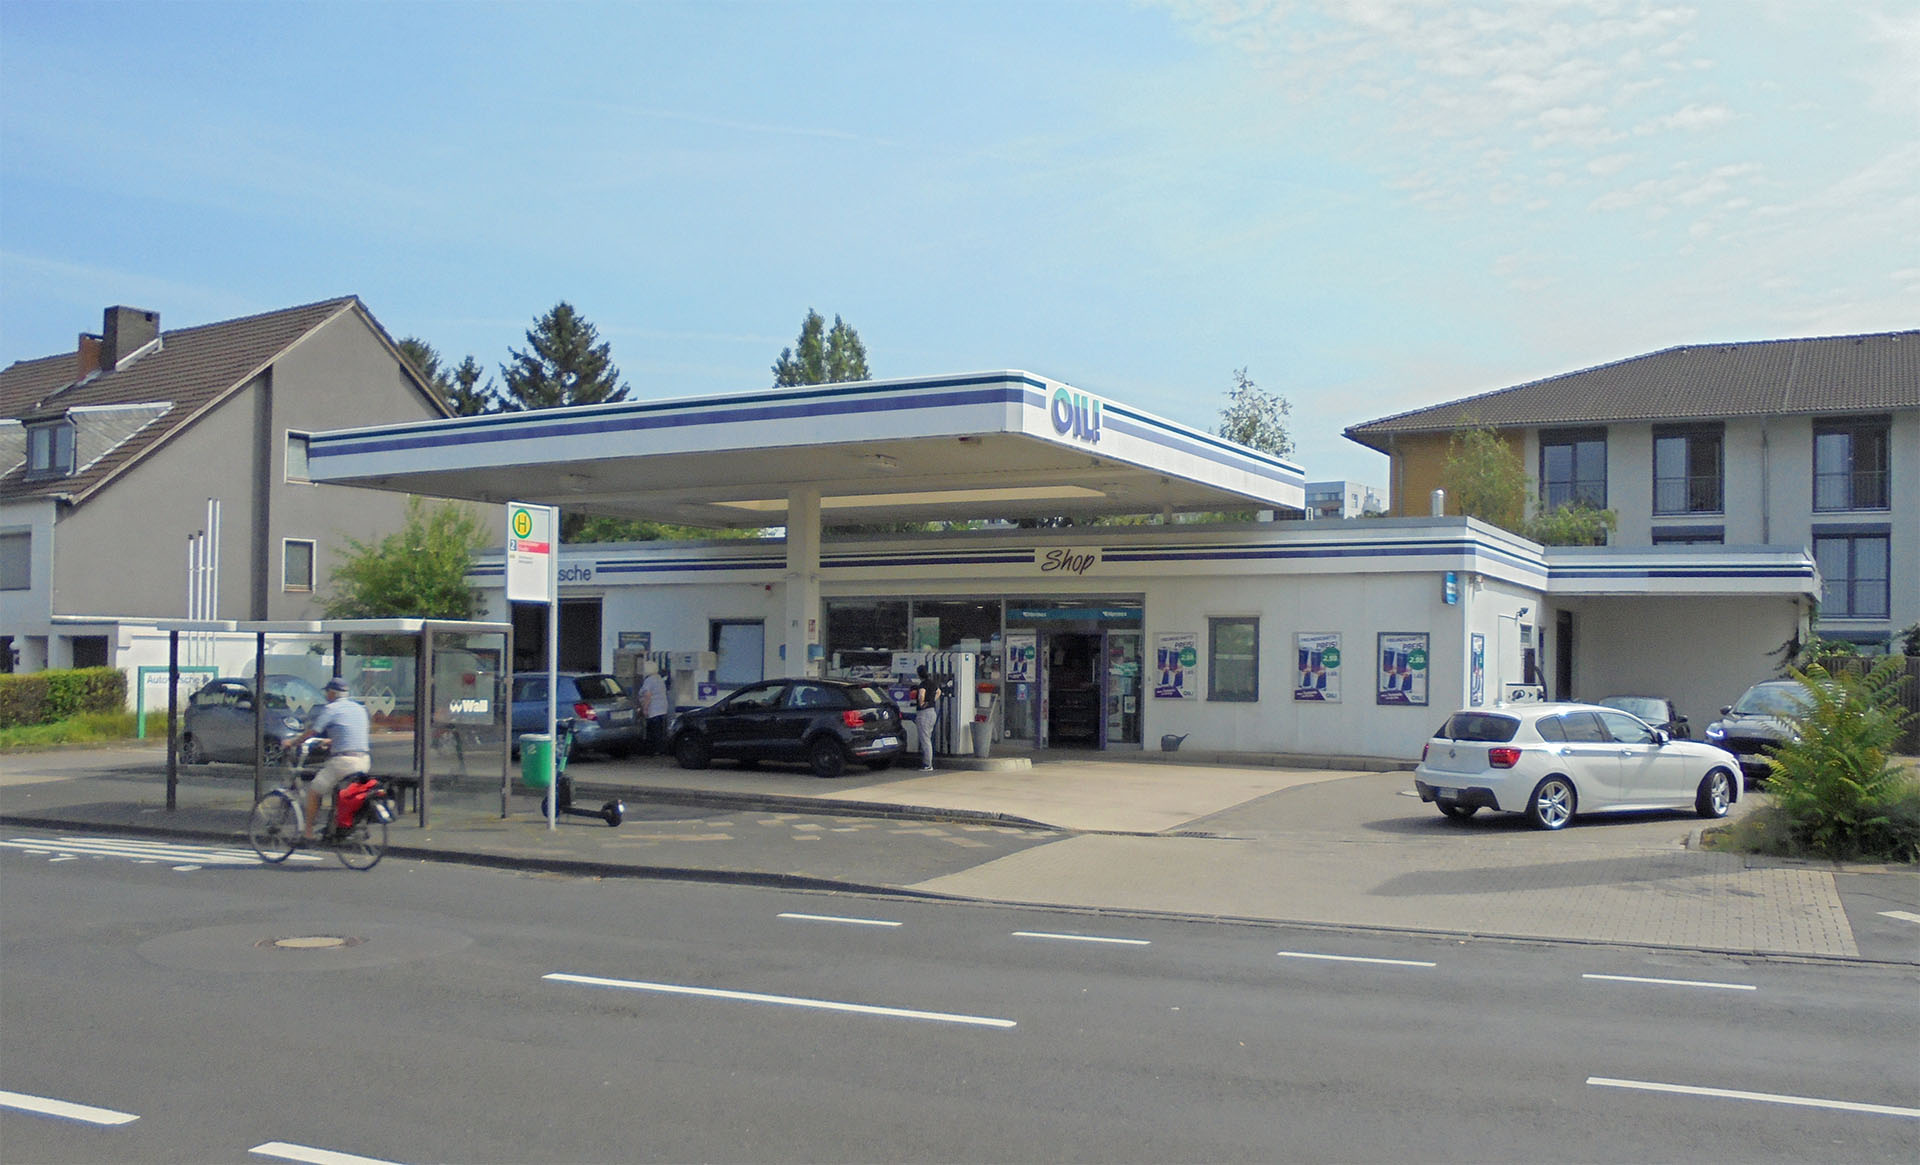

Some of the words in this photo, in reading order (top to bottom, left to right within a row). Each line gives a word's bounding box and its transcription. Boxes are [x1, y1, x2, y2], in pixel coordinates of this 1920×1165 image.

[1051, 387, 1100, 445] OIL!
[517, 514, 527, 533] H
[510, 540, 517, 550] 2
[1041, 548, 1096, 575] Shop
[461, 699, 489, 713] Wall
